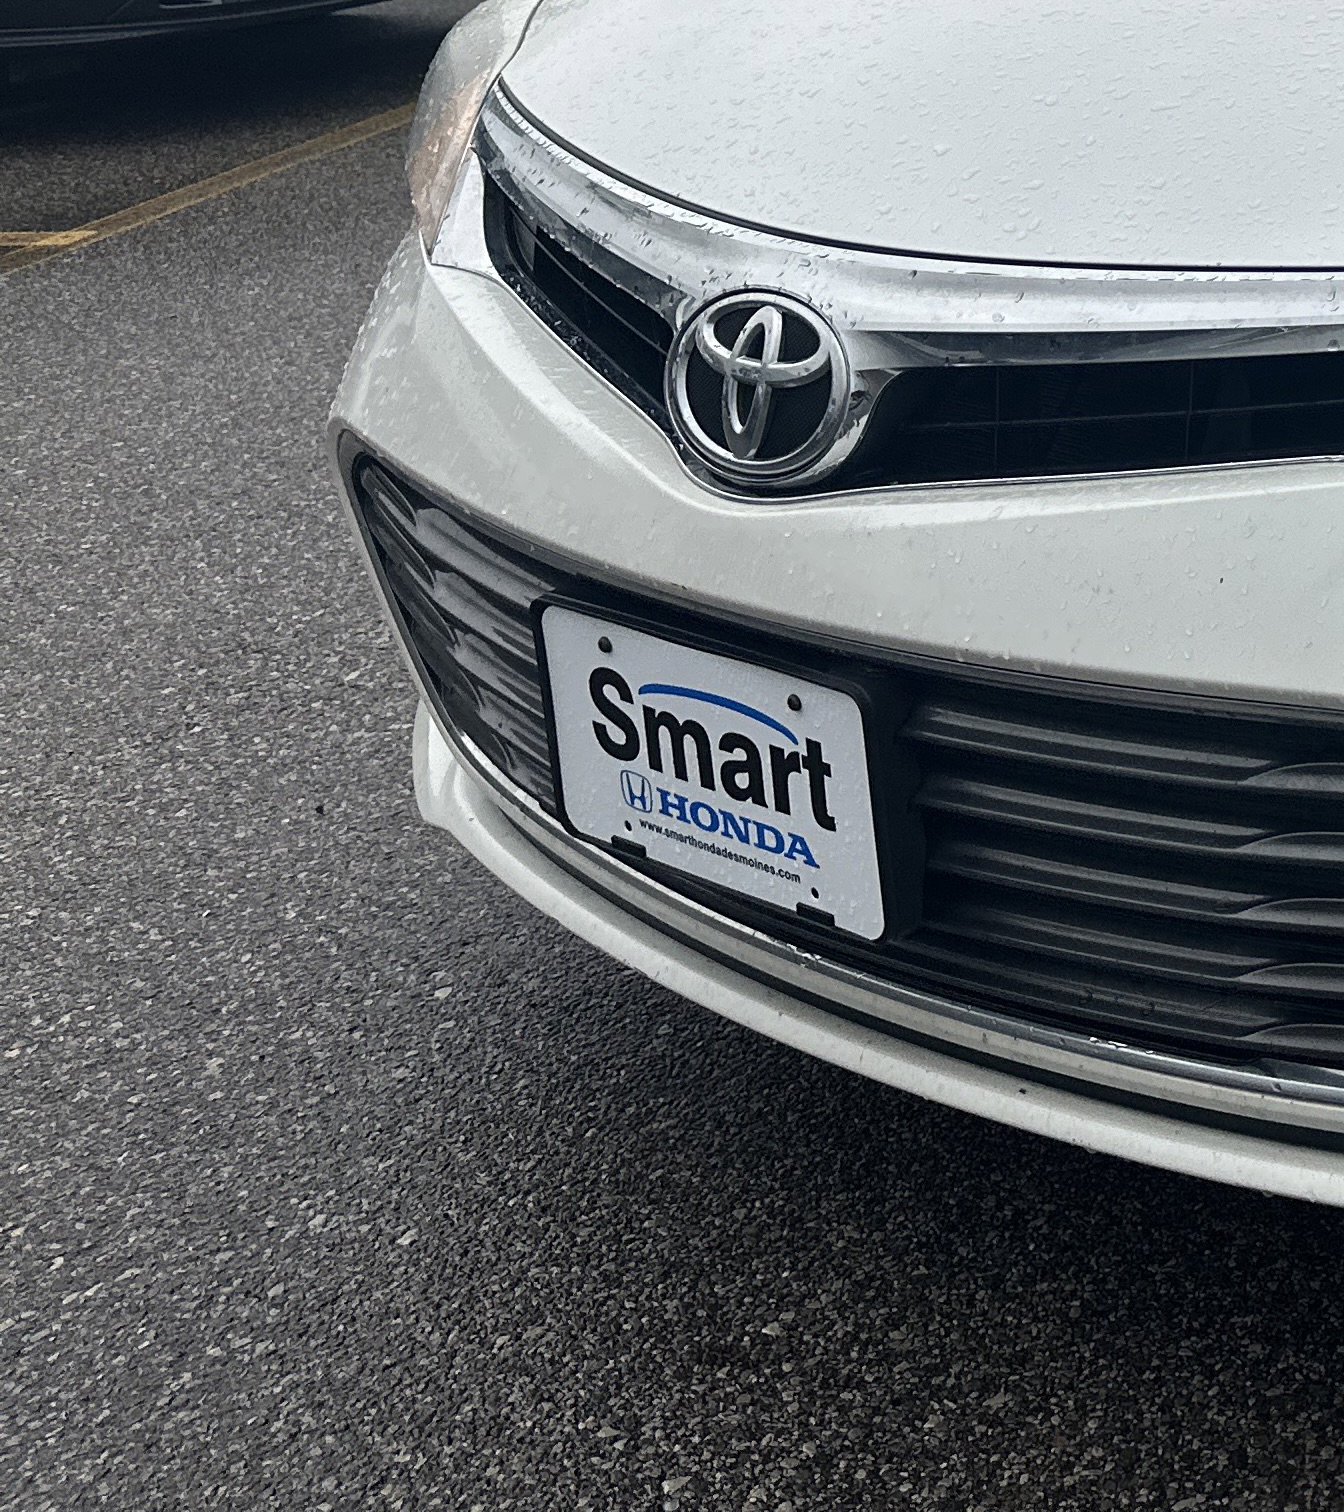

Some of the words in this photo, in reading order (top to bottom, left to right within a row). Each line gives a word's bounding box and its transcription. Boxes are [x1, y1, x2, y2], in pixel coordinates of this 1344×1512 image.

[588, 666, 837, 832] Smart
[639, 819, 800, 883] www.smarthondadesmoines.com
[656, 787, 820, 869] HONDA
